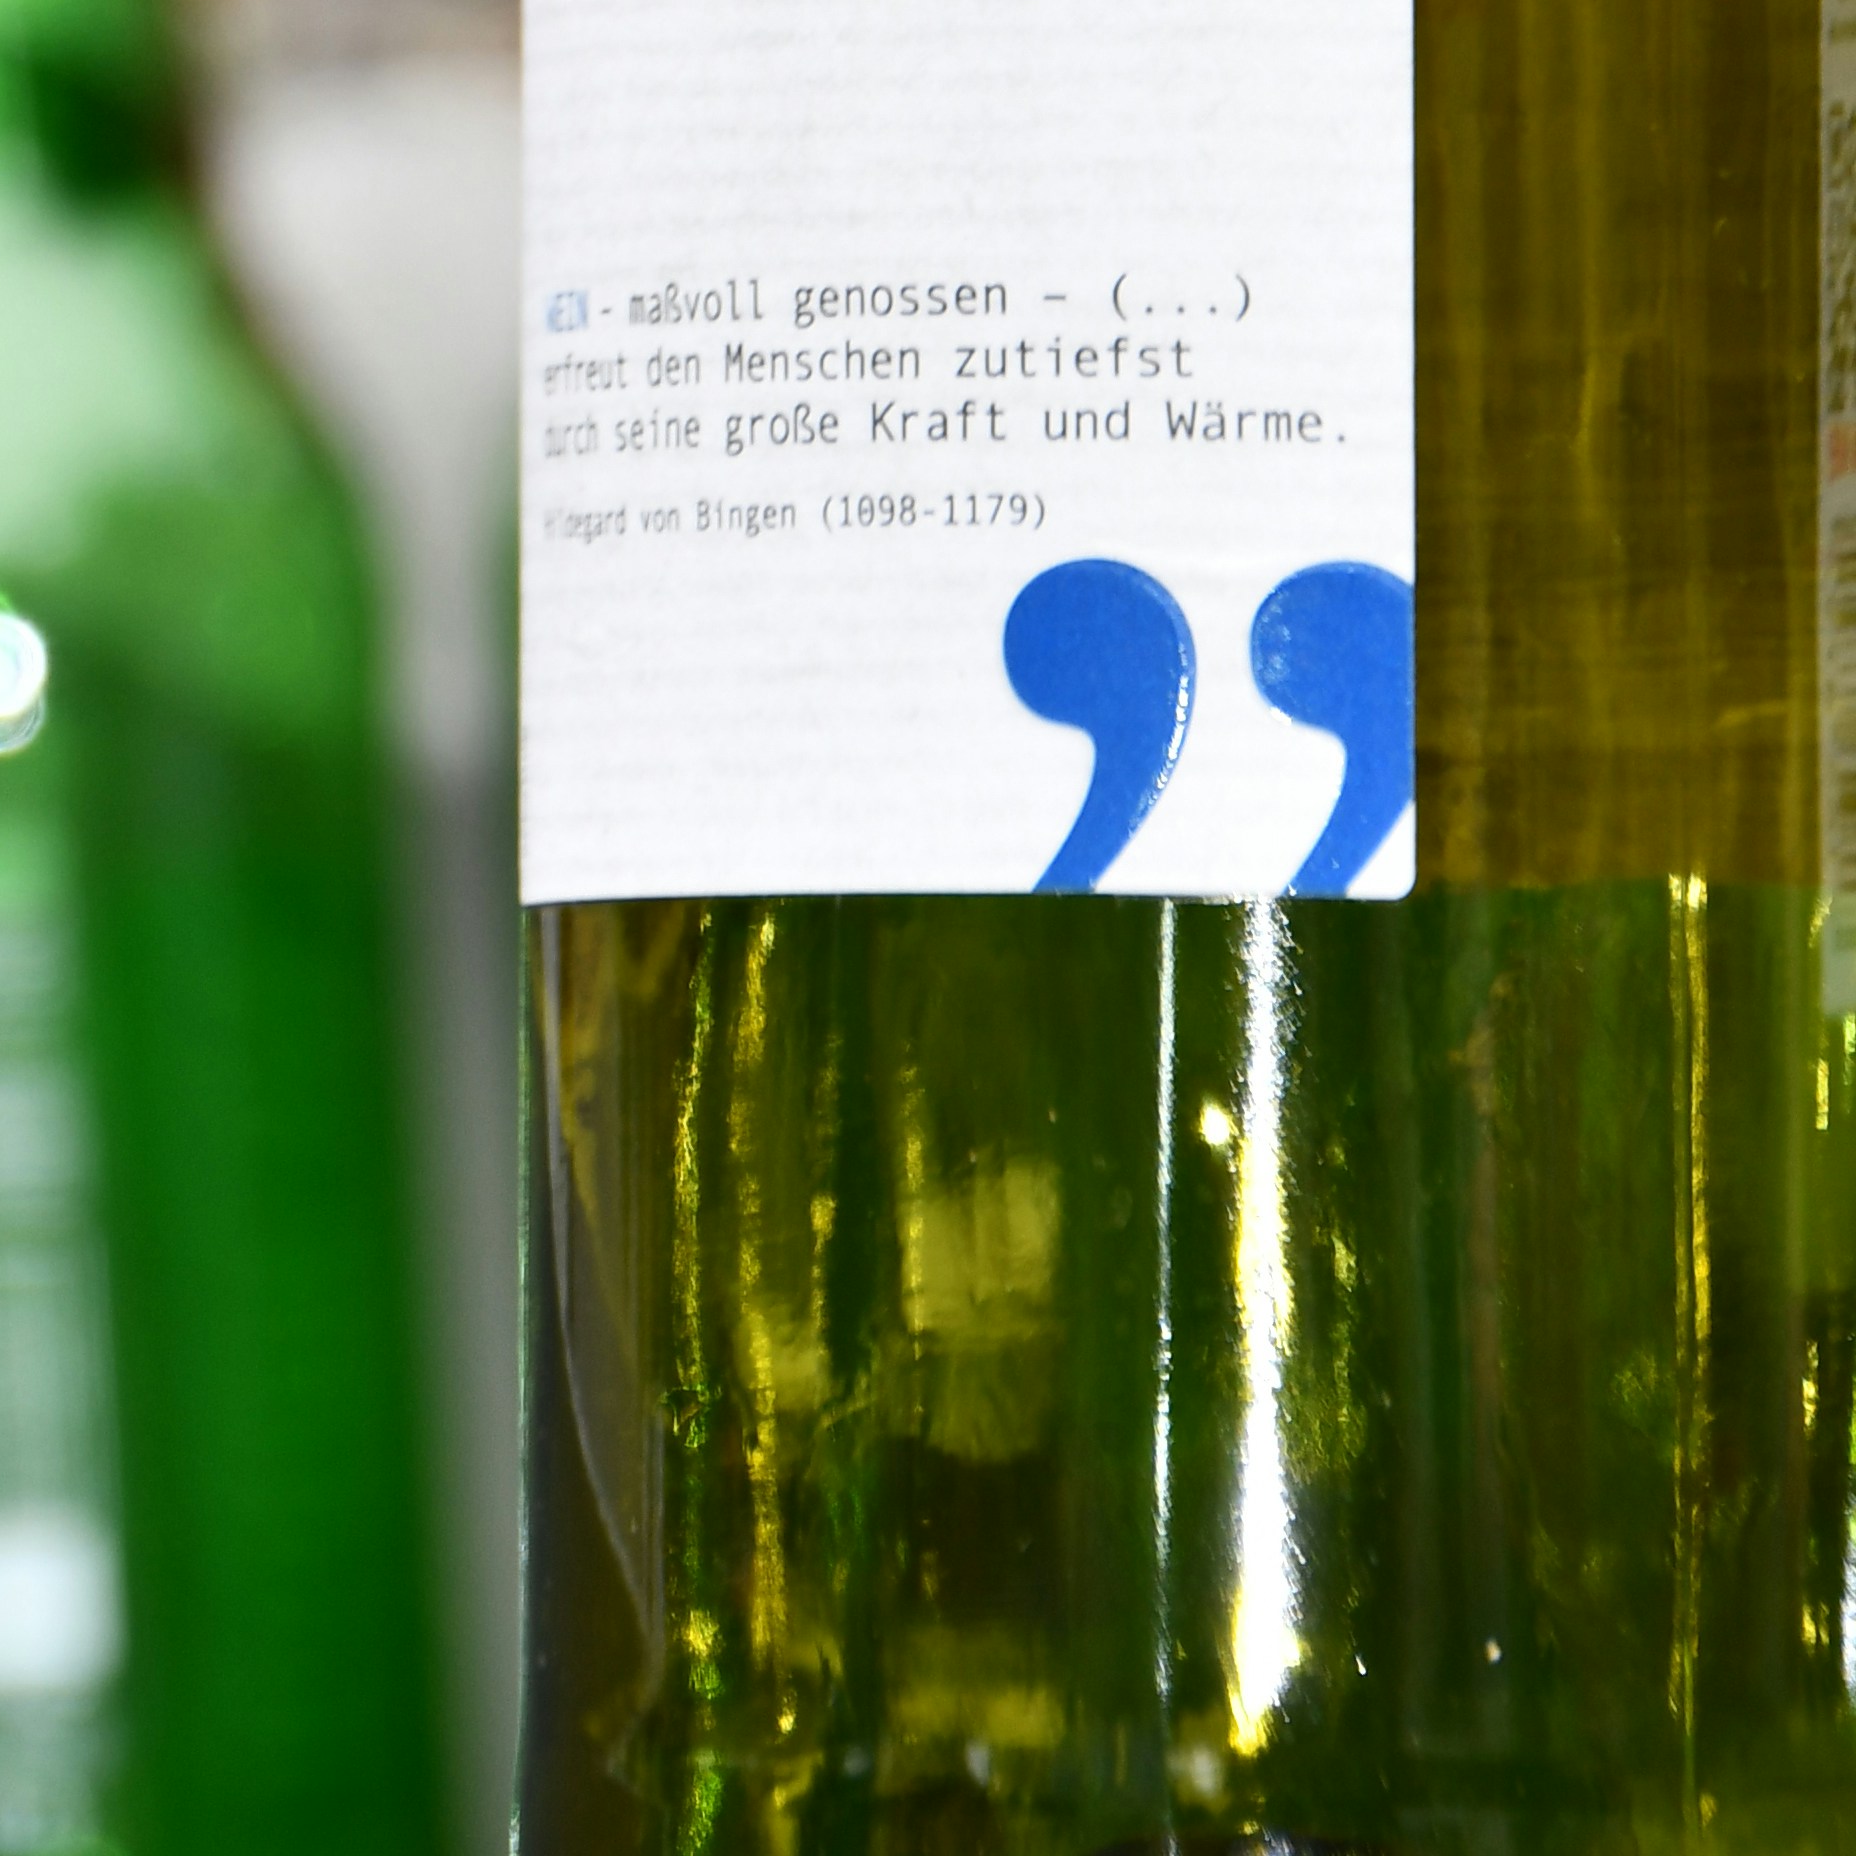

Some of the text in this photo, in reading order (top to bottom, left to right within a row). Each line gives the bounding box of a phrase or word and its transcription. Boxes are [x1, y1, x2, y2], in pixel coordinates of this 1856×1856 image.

[629, 278, 763, 325] maßvoll
[794, 283, 1006, 329] genossen
[1112, 273, 1251, 321] (...)
[647, 348, 700, 387] den
[725, 340, 920, 382] Menschen
[956, 336, 1191, 378] zutiefst
[615, 409, 700, 452] seine
[725, 402, 839, 457] große
[871, 399, 1005, 442] Kraft
[1044, 400, 1130, 441] und
[1165, 400, 1345, 443] Wärme.
[640, 508, 680, 533] von
[697, 499, 796, 538] Bingen
[822, 493, 1045, 529] (1098-1179)
